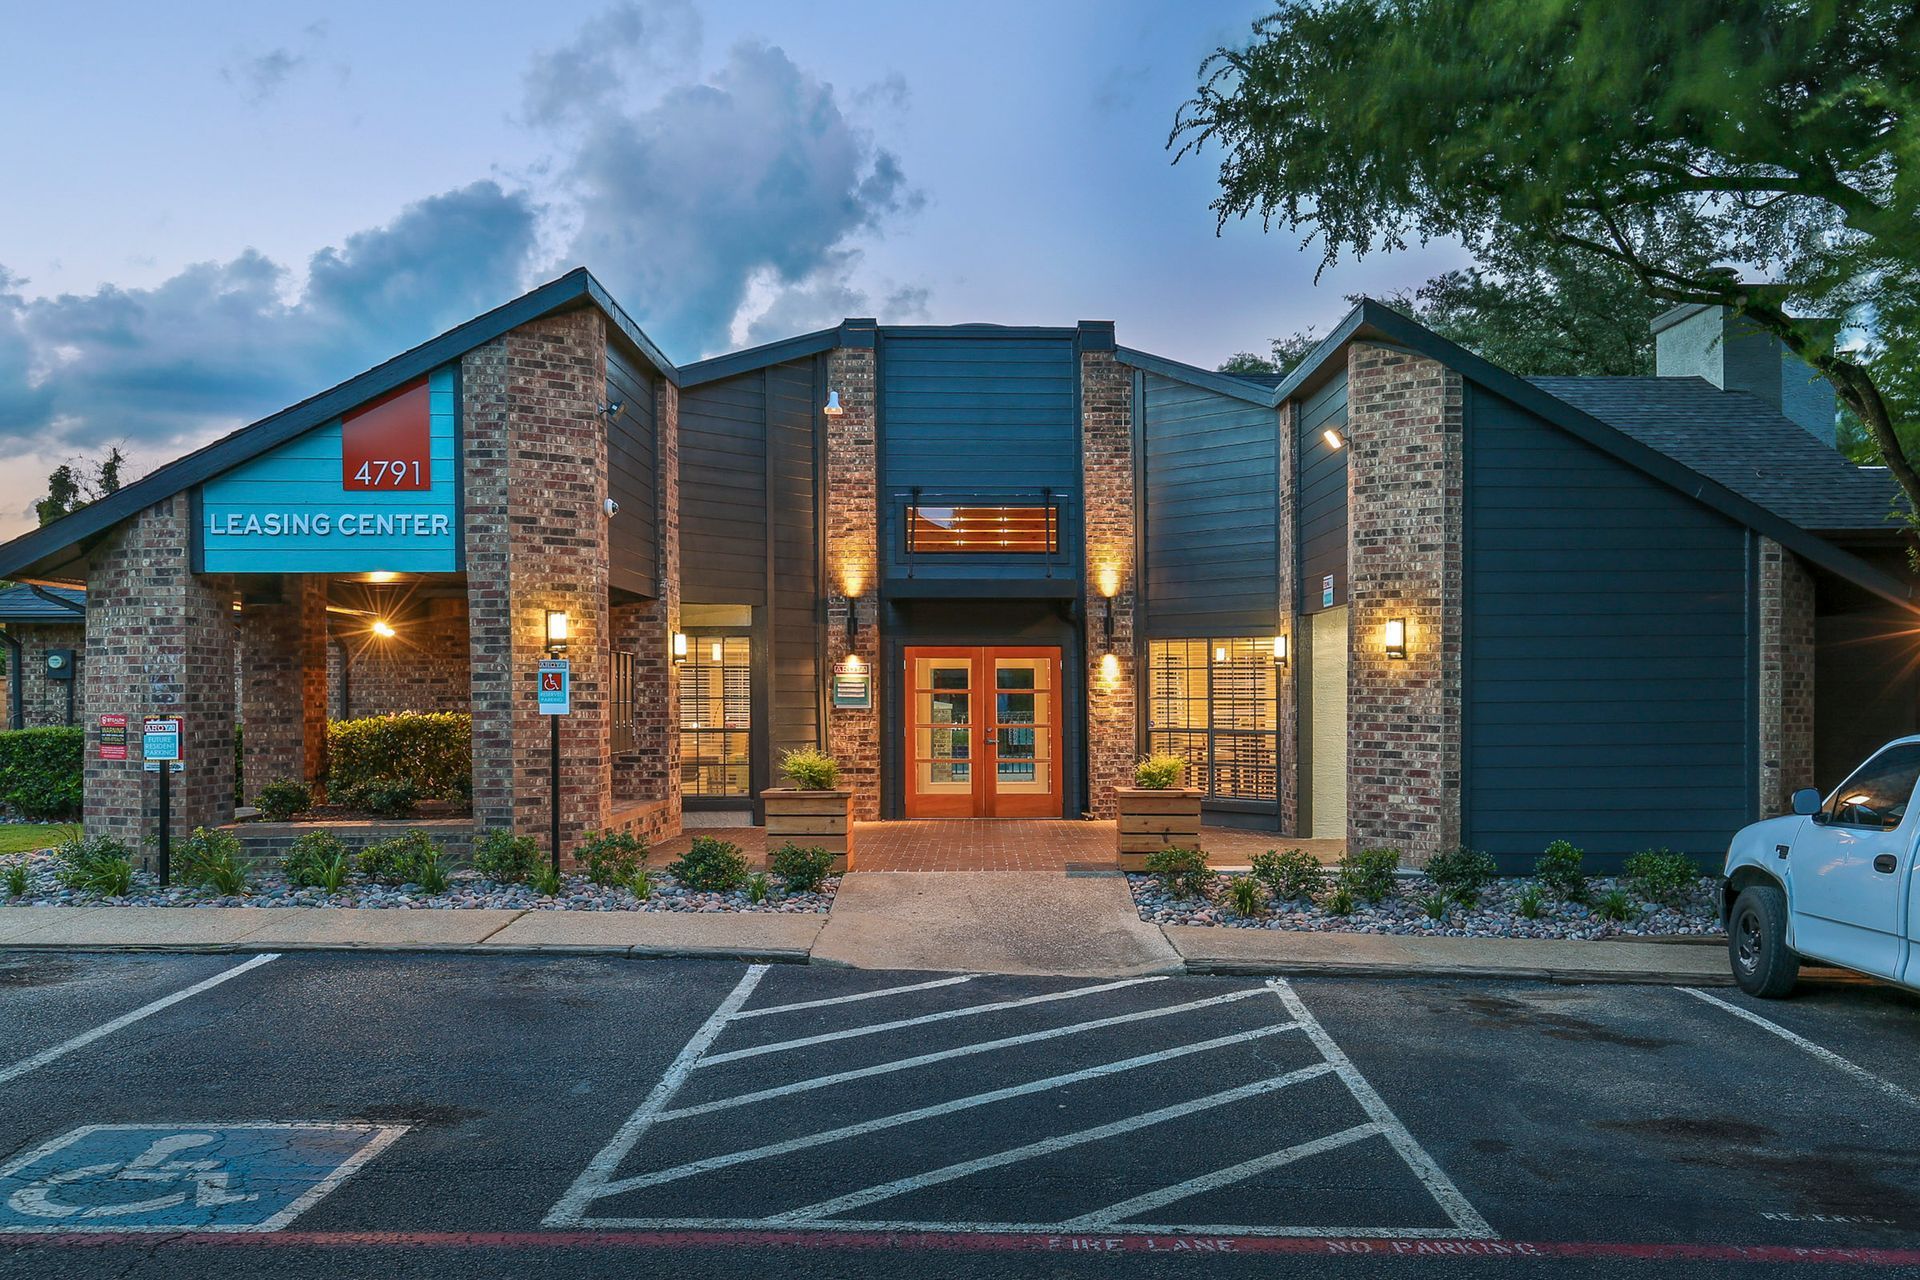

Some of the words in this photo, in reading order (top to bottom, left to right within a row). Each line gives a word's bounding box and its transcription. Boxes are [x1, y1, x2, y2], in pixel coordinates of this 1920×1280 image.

[354, 461, 421, 486] 4791
[210, 513, 331, 536] LEASING
[338, 513, 450, 536] CENTER
[1148, 1239, 1240, 1252] LANE
[1326, 1241, 1372, 1254] NO
[1391, 1241, 1541, 1256] PARKING
